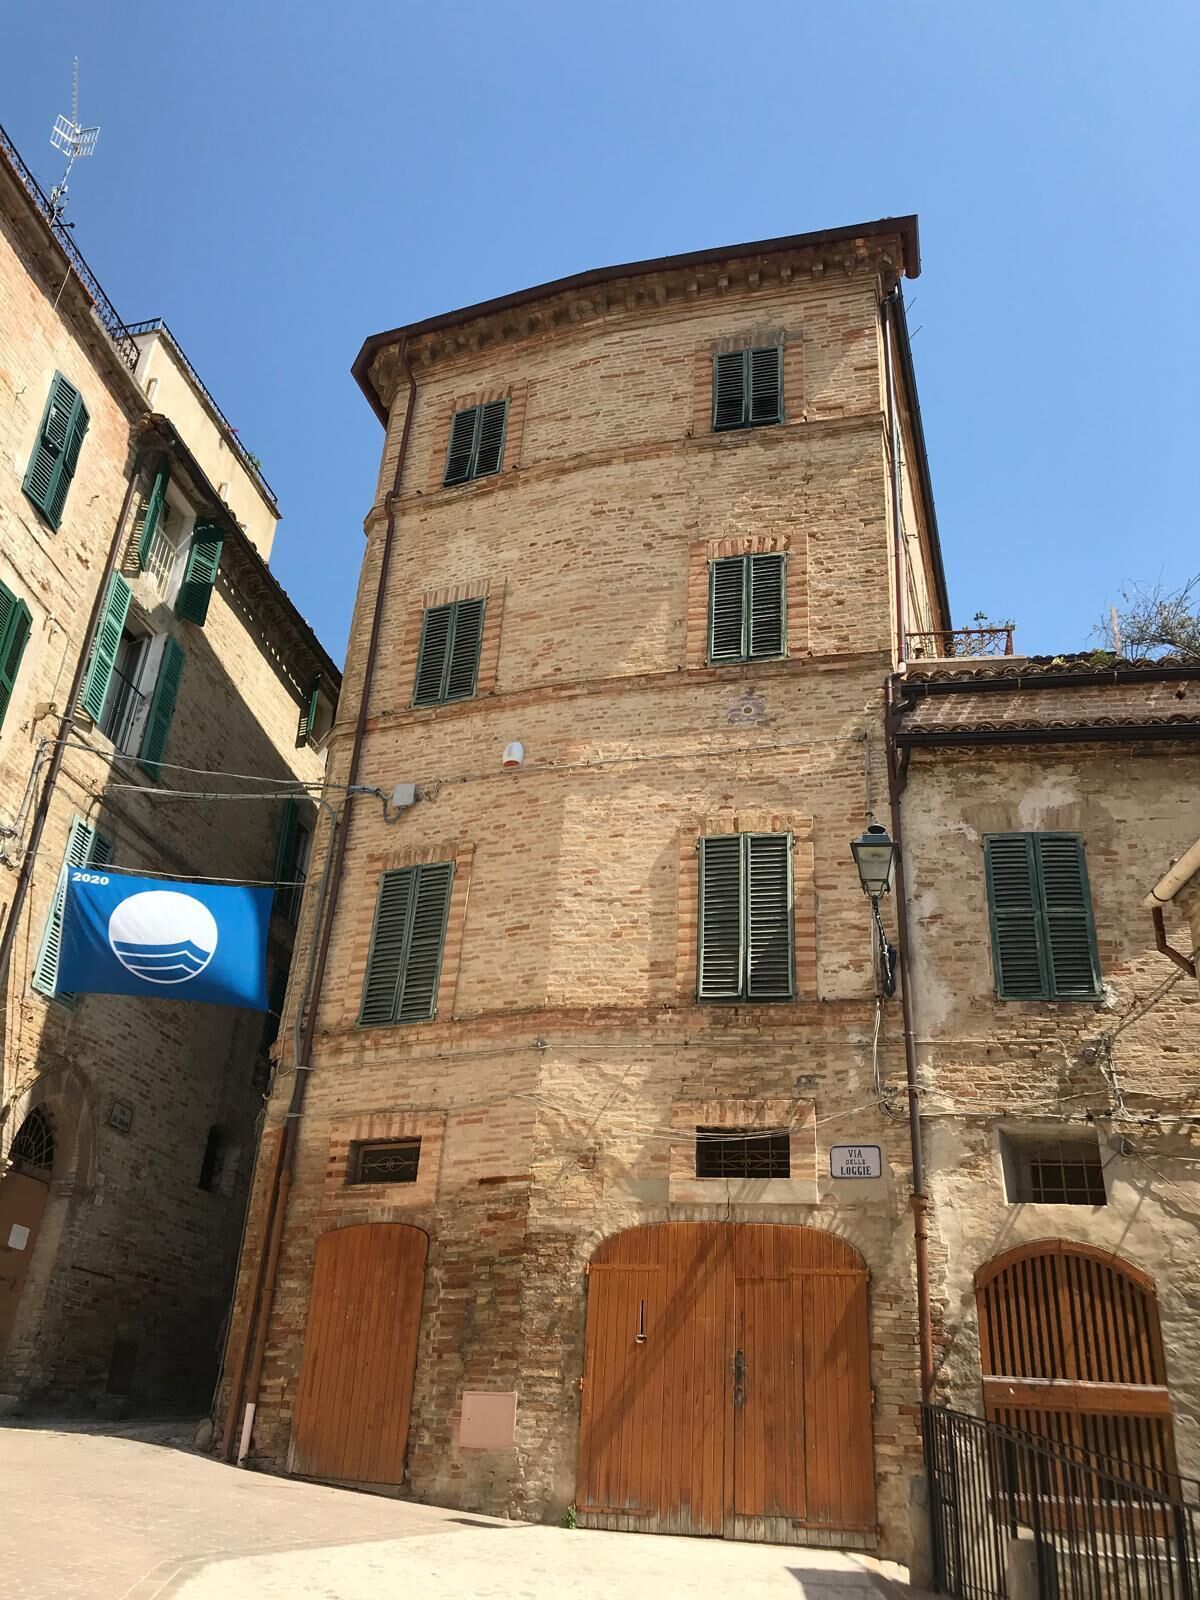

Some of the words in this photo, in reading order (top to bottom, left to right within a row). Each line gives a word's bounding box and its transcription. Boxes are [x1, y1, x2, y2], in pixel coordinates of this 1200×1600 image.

[72, 872, 109, 885] 2020
[848, 1149, 862, 1158] VIA
[841, 1166, 871, 1175] LOGGIE
